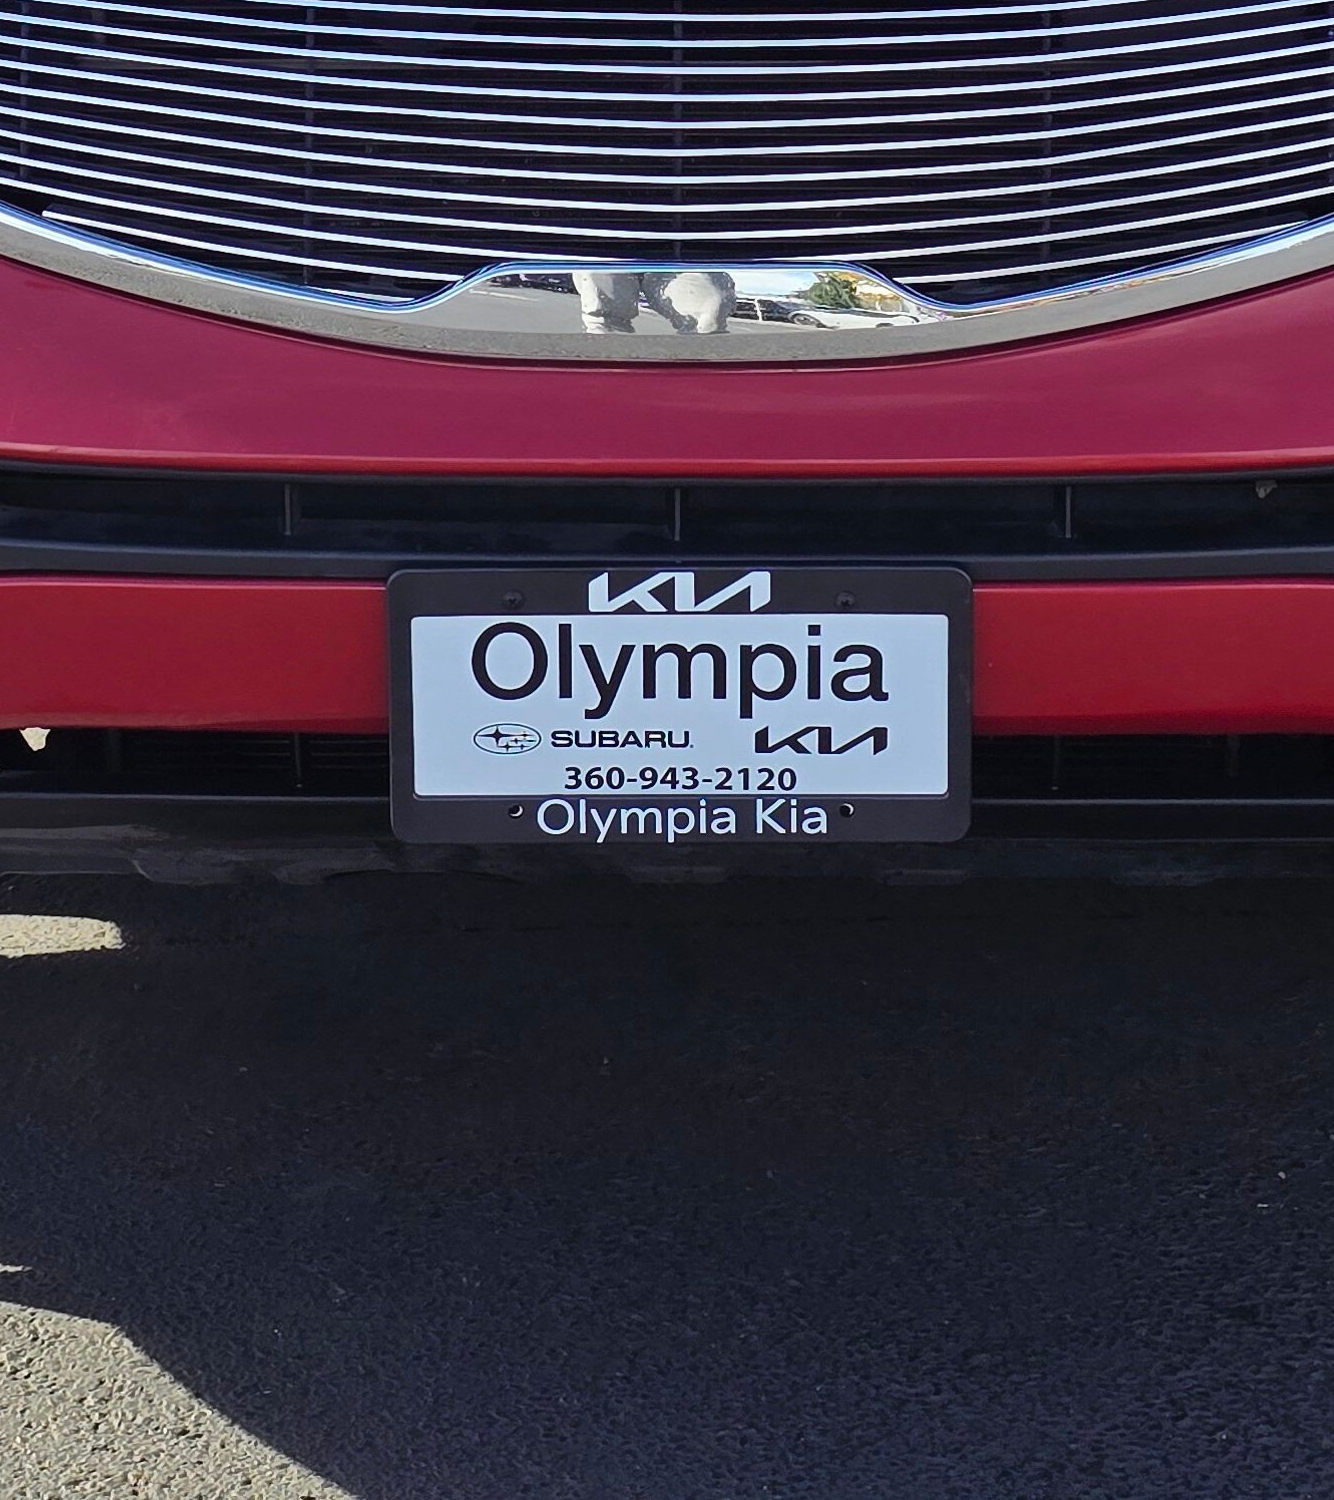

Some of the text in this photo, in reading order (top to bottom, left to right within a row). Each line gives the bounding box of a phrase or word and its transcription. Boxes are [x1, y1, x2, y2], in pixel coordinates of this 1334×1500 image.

[589, 571, 771, 612] KIA
[471, 621, 889, 720] Olympia
[551, 730, 691, 749] SUBARU
[754, 726, 889, 756] KIA
[564, 766, 798, 792] 360-943-2120
[536, 799, 829, 844] Olympia Kia
